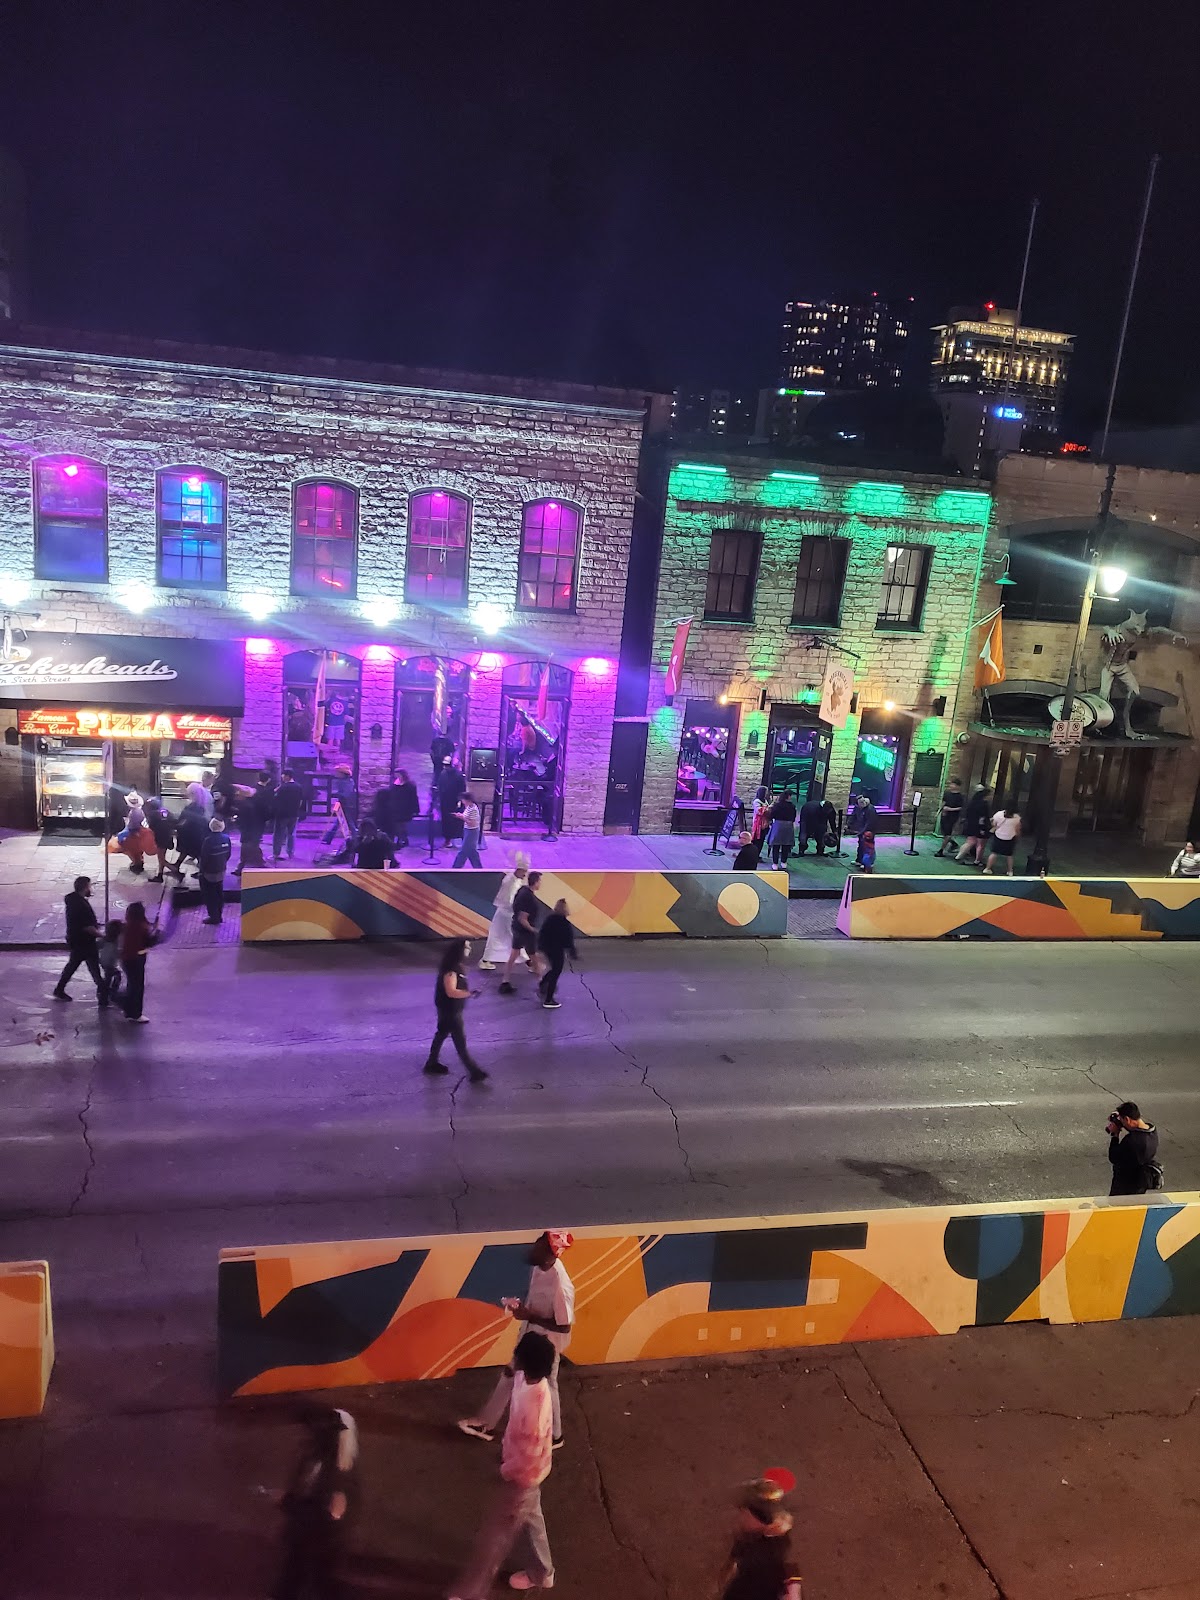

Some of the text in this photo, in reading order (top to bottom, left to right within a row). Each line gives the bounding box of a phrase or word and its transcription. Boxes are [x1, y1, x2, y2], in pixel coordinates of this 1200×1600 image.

[0, 656, 172, 676] eckerheads
[11, 675, 37, 684] Sixth
[28, 710, 68, 723] Famous
[20, 723, 75, 735] Beer Crust
[75, 711, 232, 739] PIZZA Handmade
